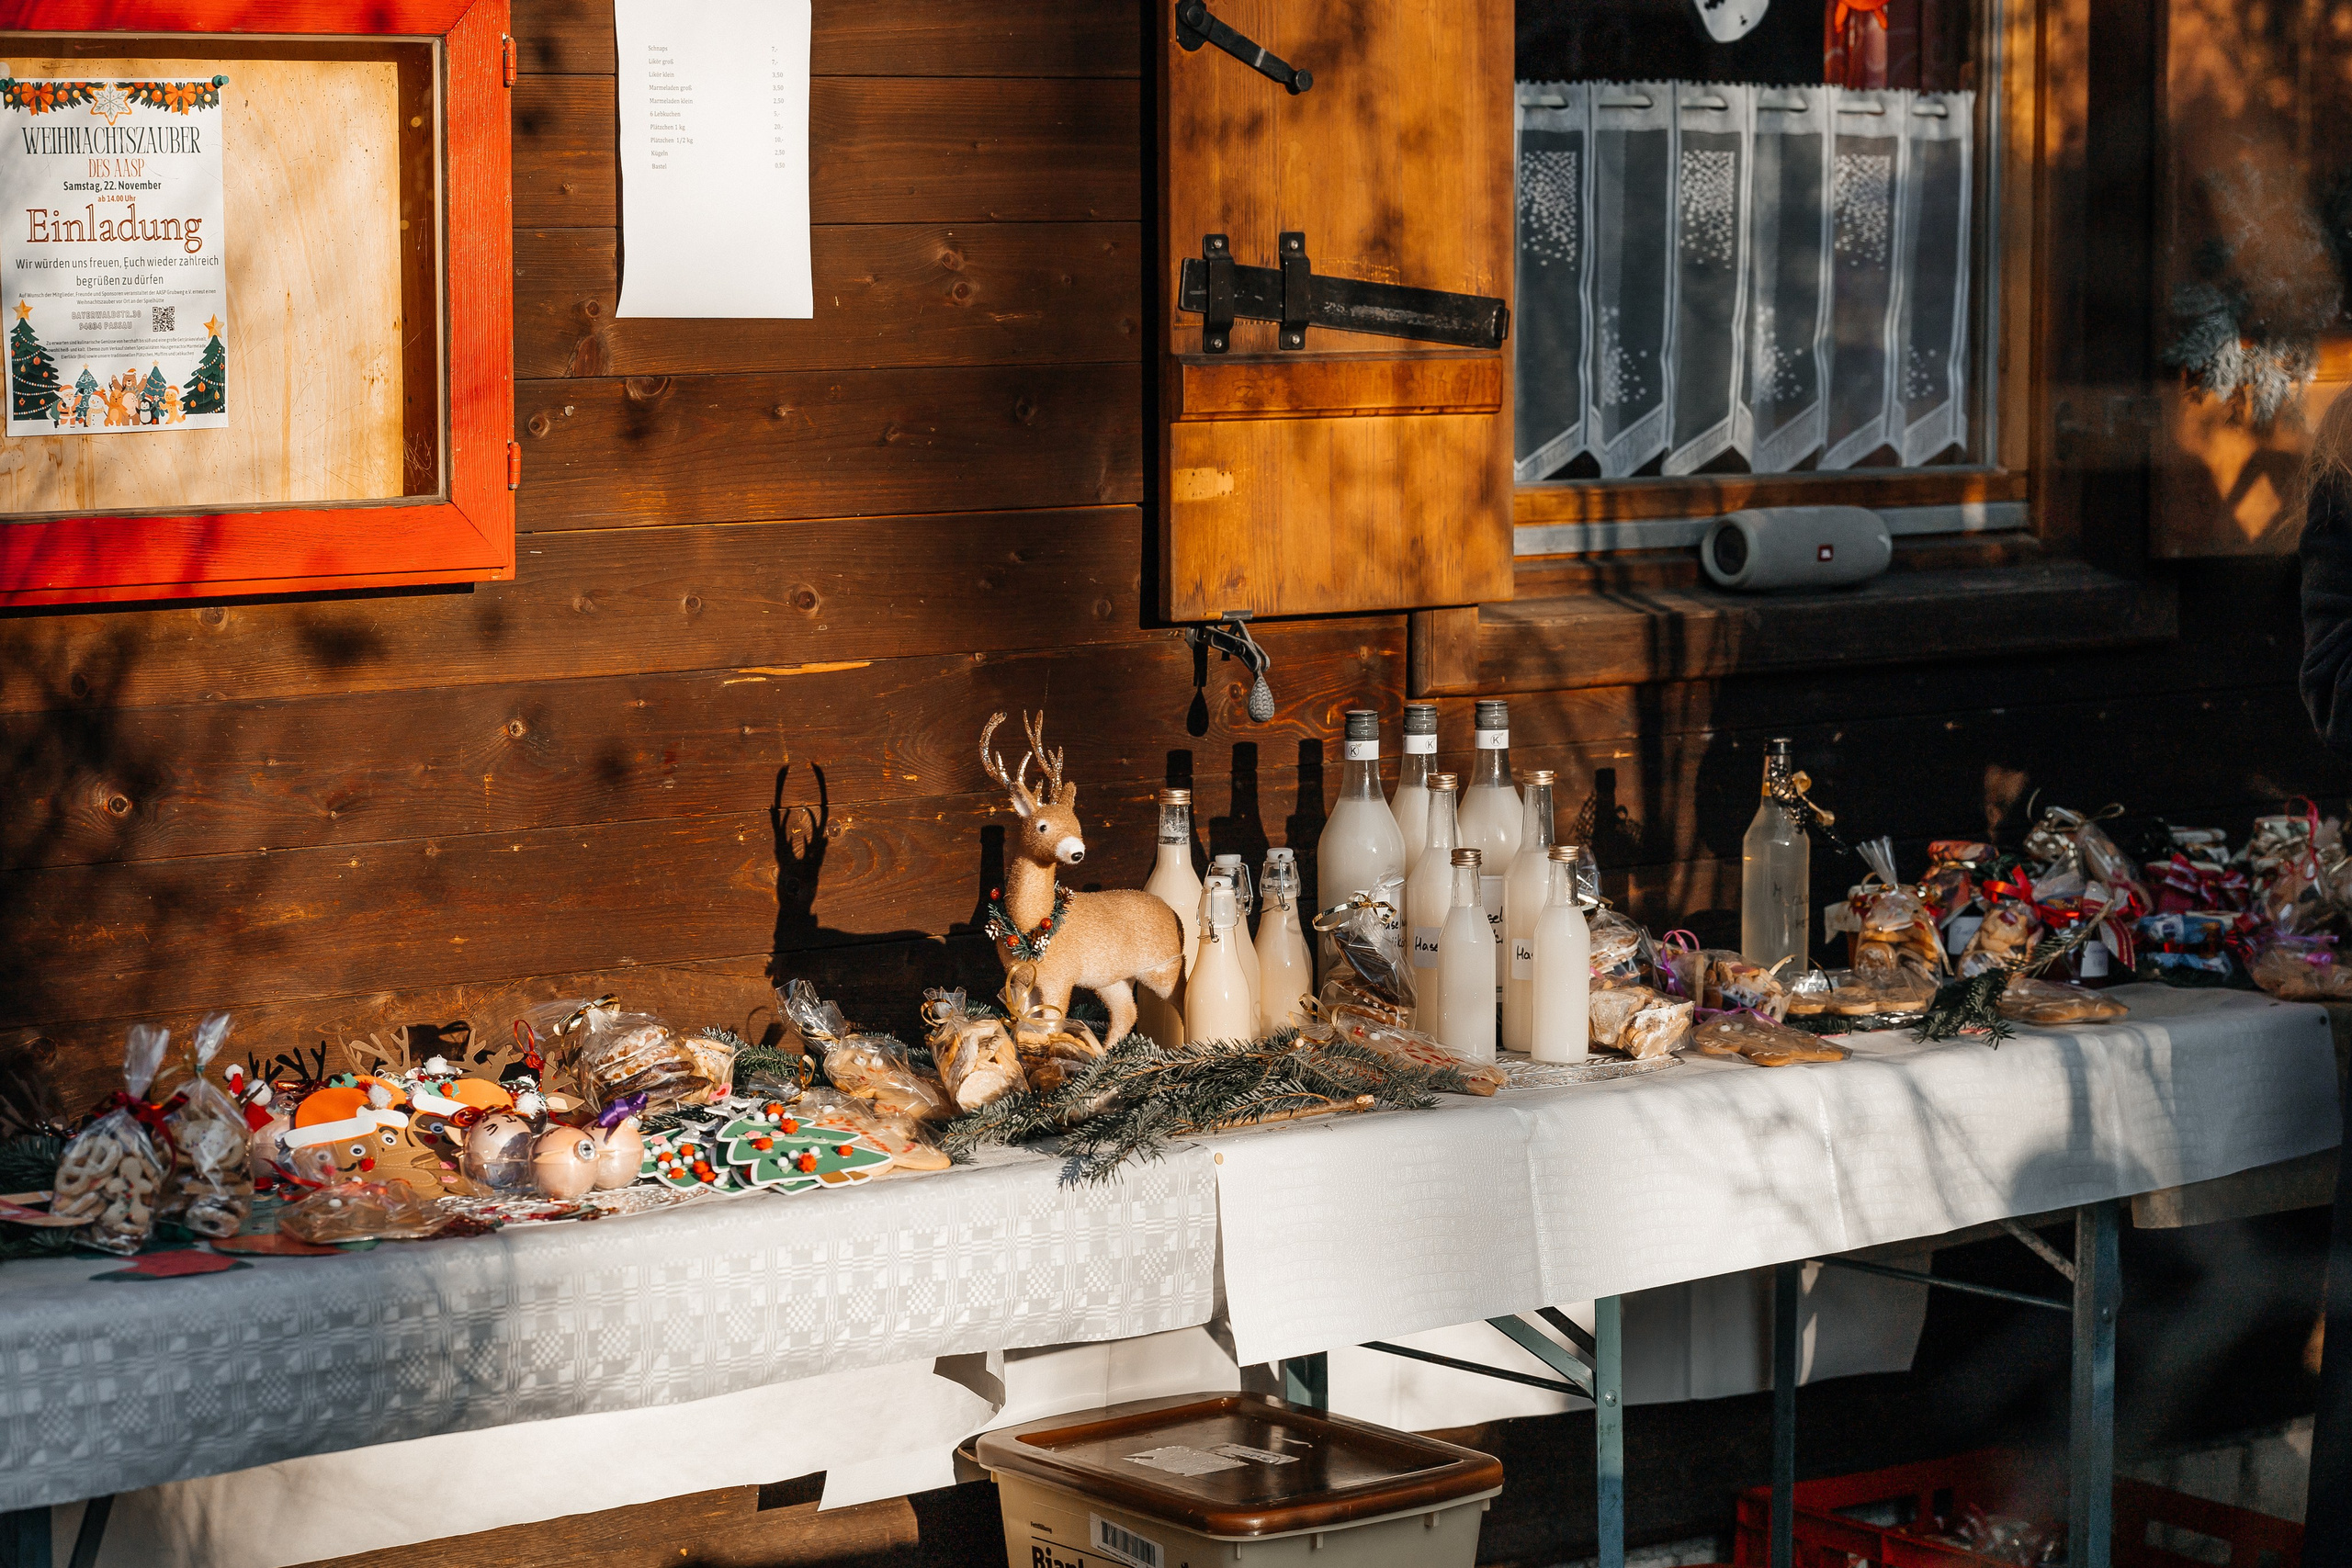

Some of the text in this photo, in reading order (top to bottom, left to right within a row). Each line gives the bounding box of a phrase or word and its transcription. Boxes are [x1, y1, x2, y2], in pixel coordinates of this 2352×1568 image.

[22, 126, 201, 155] WEIHNACHTSZAUBER
[88, 158, 145, 178] DES AASP
[63, 180, 162, 193] Samstag, 22. November
[26, 203, 203, 254] Einladung
[16, 258, 32, 269] Wir
[34, 257, 70, 269] würden
[89, 257, 122, 269] freuen,
[124, 256, 145, 267] Euch
[147, 256, 177, 266] wieder
[179, 255, 219, 266] zahlreich
[76, 274, 164, 288] begrüßen zu dürfen
[79, 321, 132, 330] 94034 PASSAU
[1428, 740, 1433, 749] K
[1492, 736, 1499, 744] K
[1516, 945, 1533, 960] Ha
